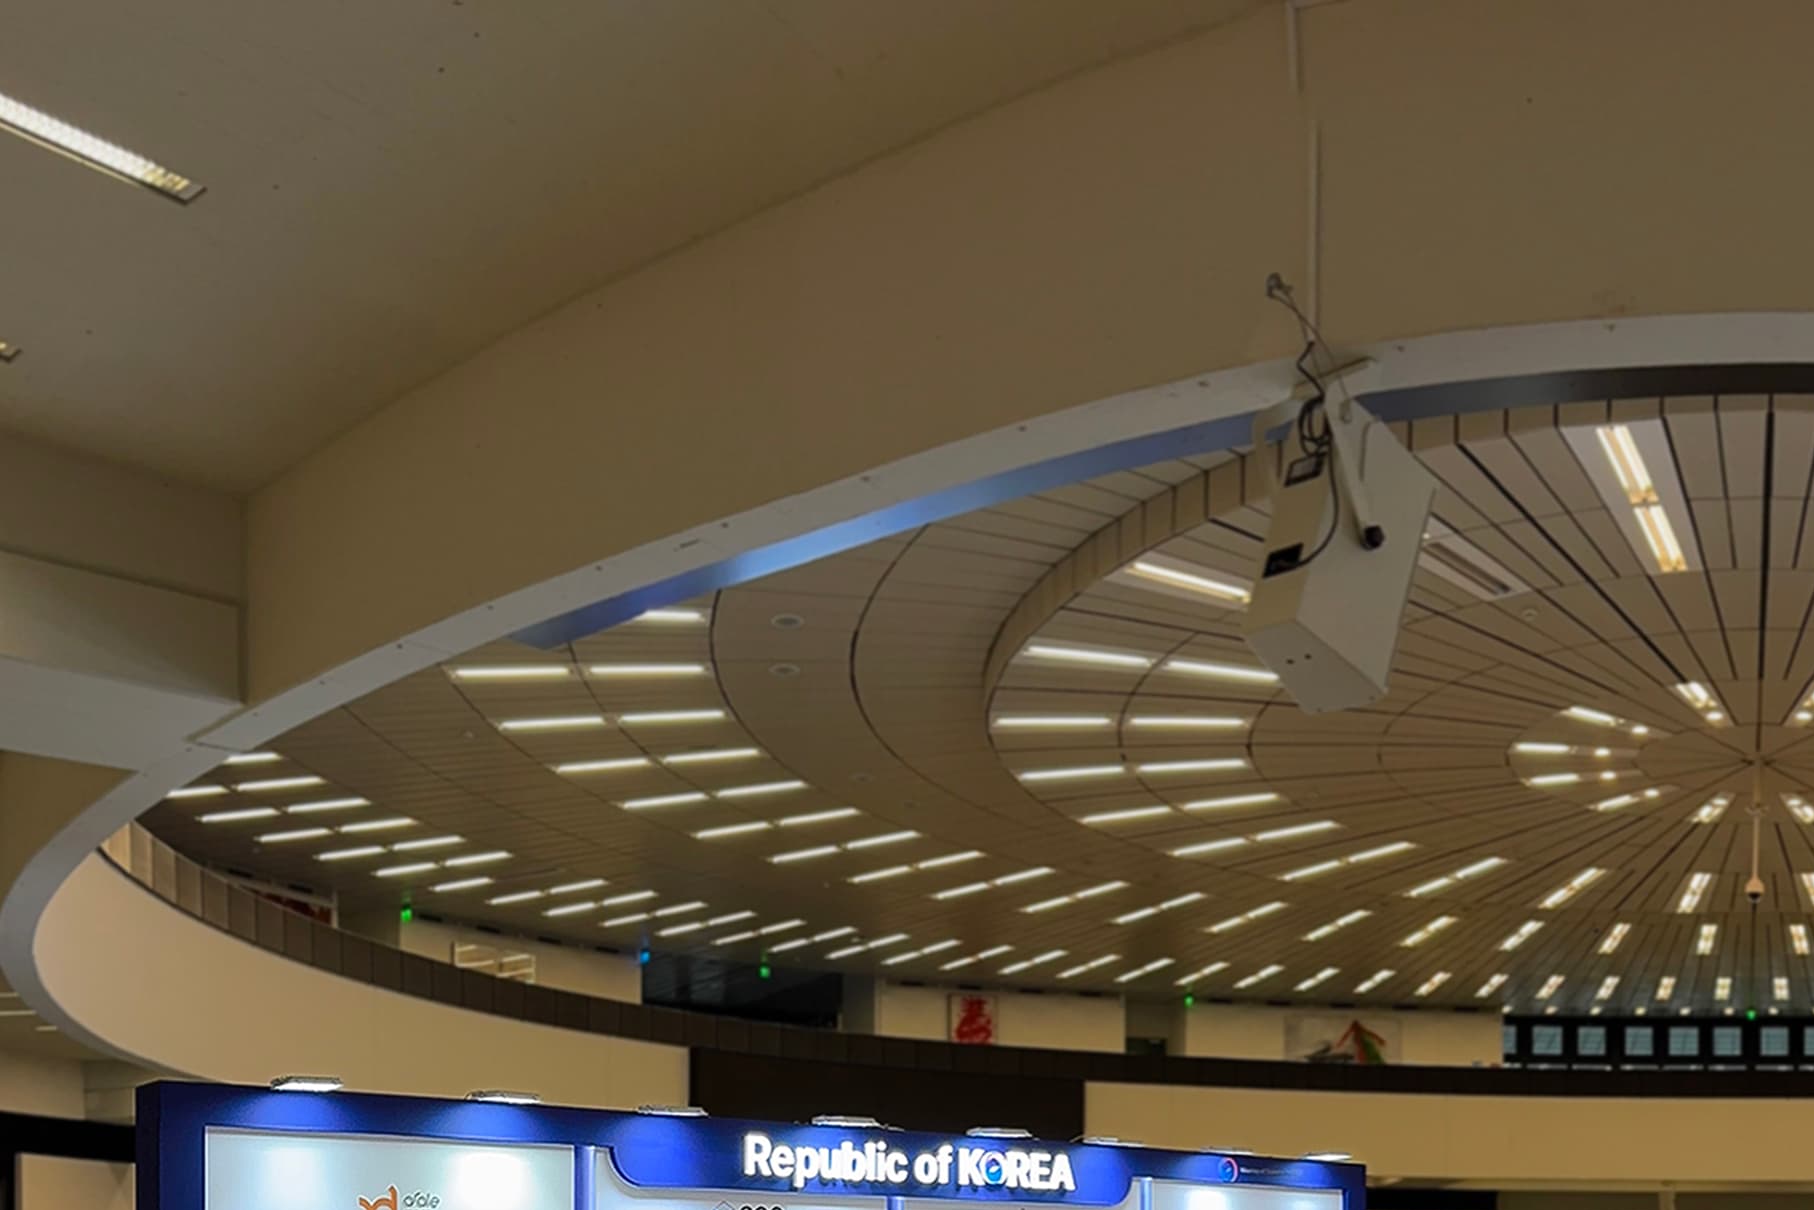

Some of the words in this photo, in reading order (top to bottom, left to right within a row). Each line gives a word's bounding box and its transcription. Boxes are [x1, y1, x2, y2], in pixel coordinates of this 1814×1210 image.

[743, 1132, 908, 1188] Republic
[914, 1145, 953, 1185] of
[958, 1148, 1076, 1190] KOREA
